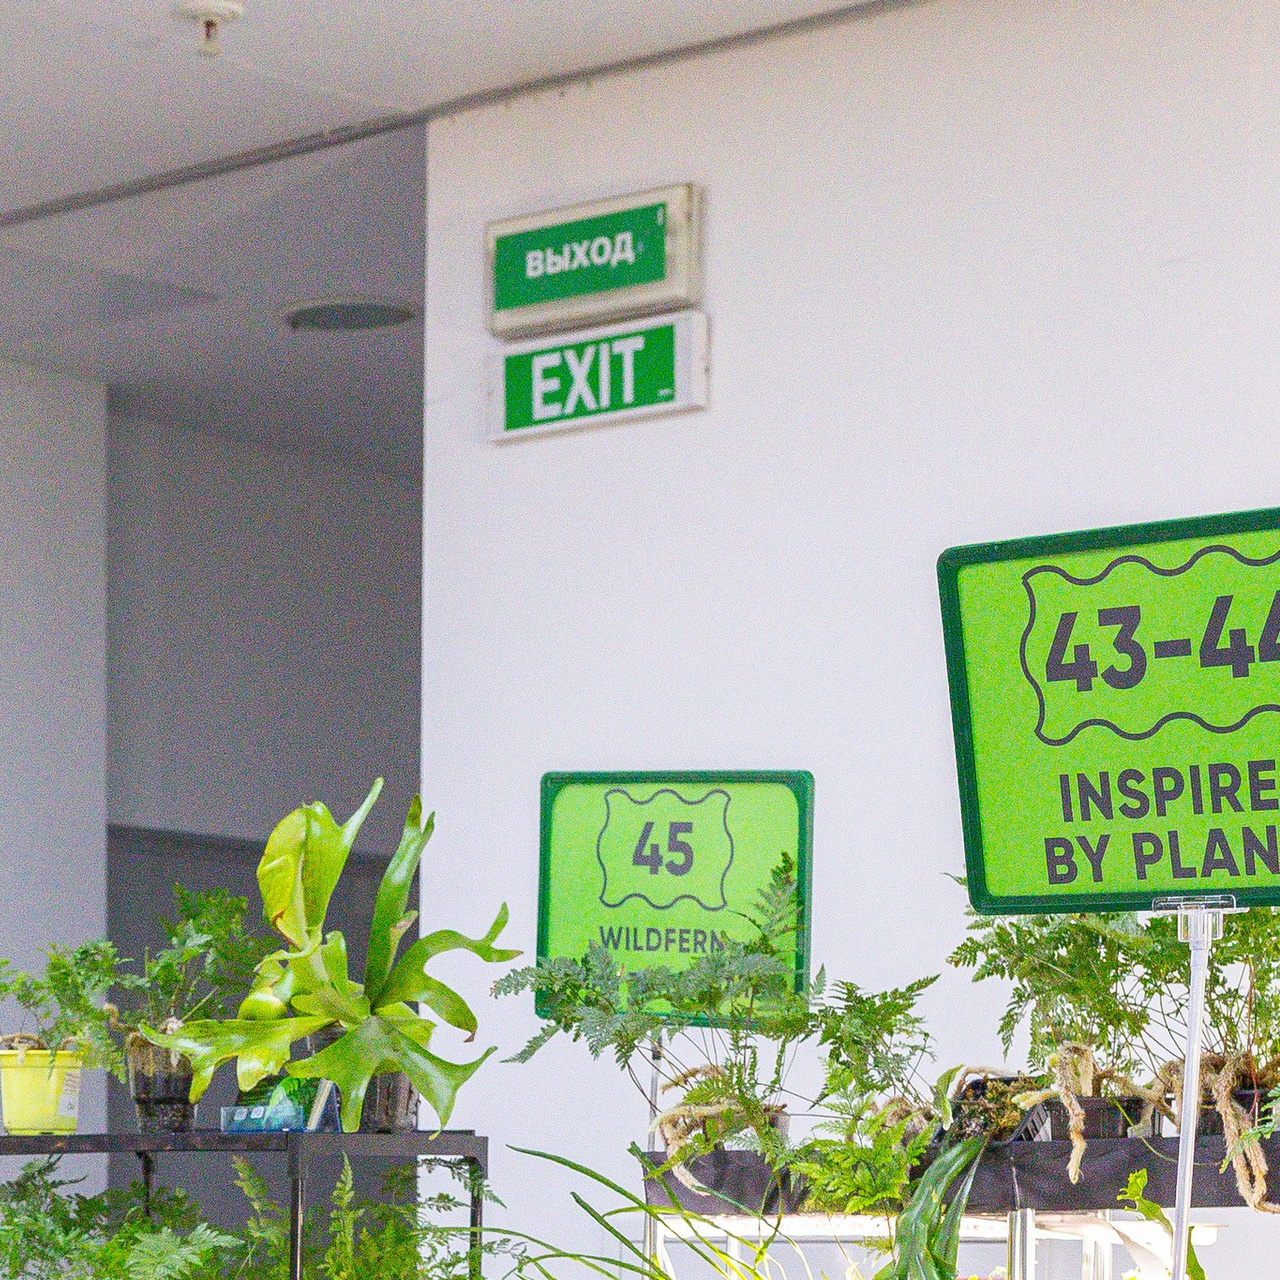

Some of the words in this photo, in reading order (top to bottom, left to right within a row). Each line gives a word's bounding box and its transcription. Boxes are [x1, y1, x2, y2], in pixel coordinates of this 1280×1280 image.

[525, 231, 636, 279] ВЫХОД
[531, 335, 646, 422] EXIT
[1059, 758, 1280, 823] INSPIRE
[631, 821, 694, 877] 45
[1044, 833, 1112, 885] BY
[1131, 825, 1280, 881] PLAN
[599, 926, 725, 952] WILDFERN
